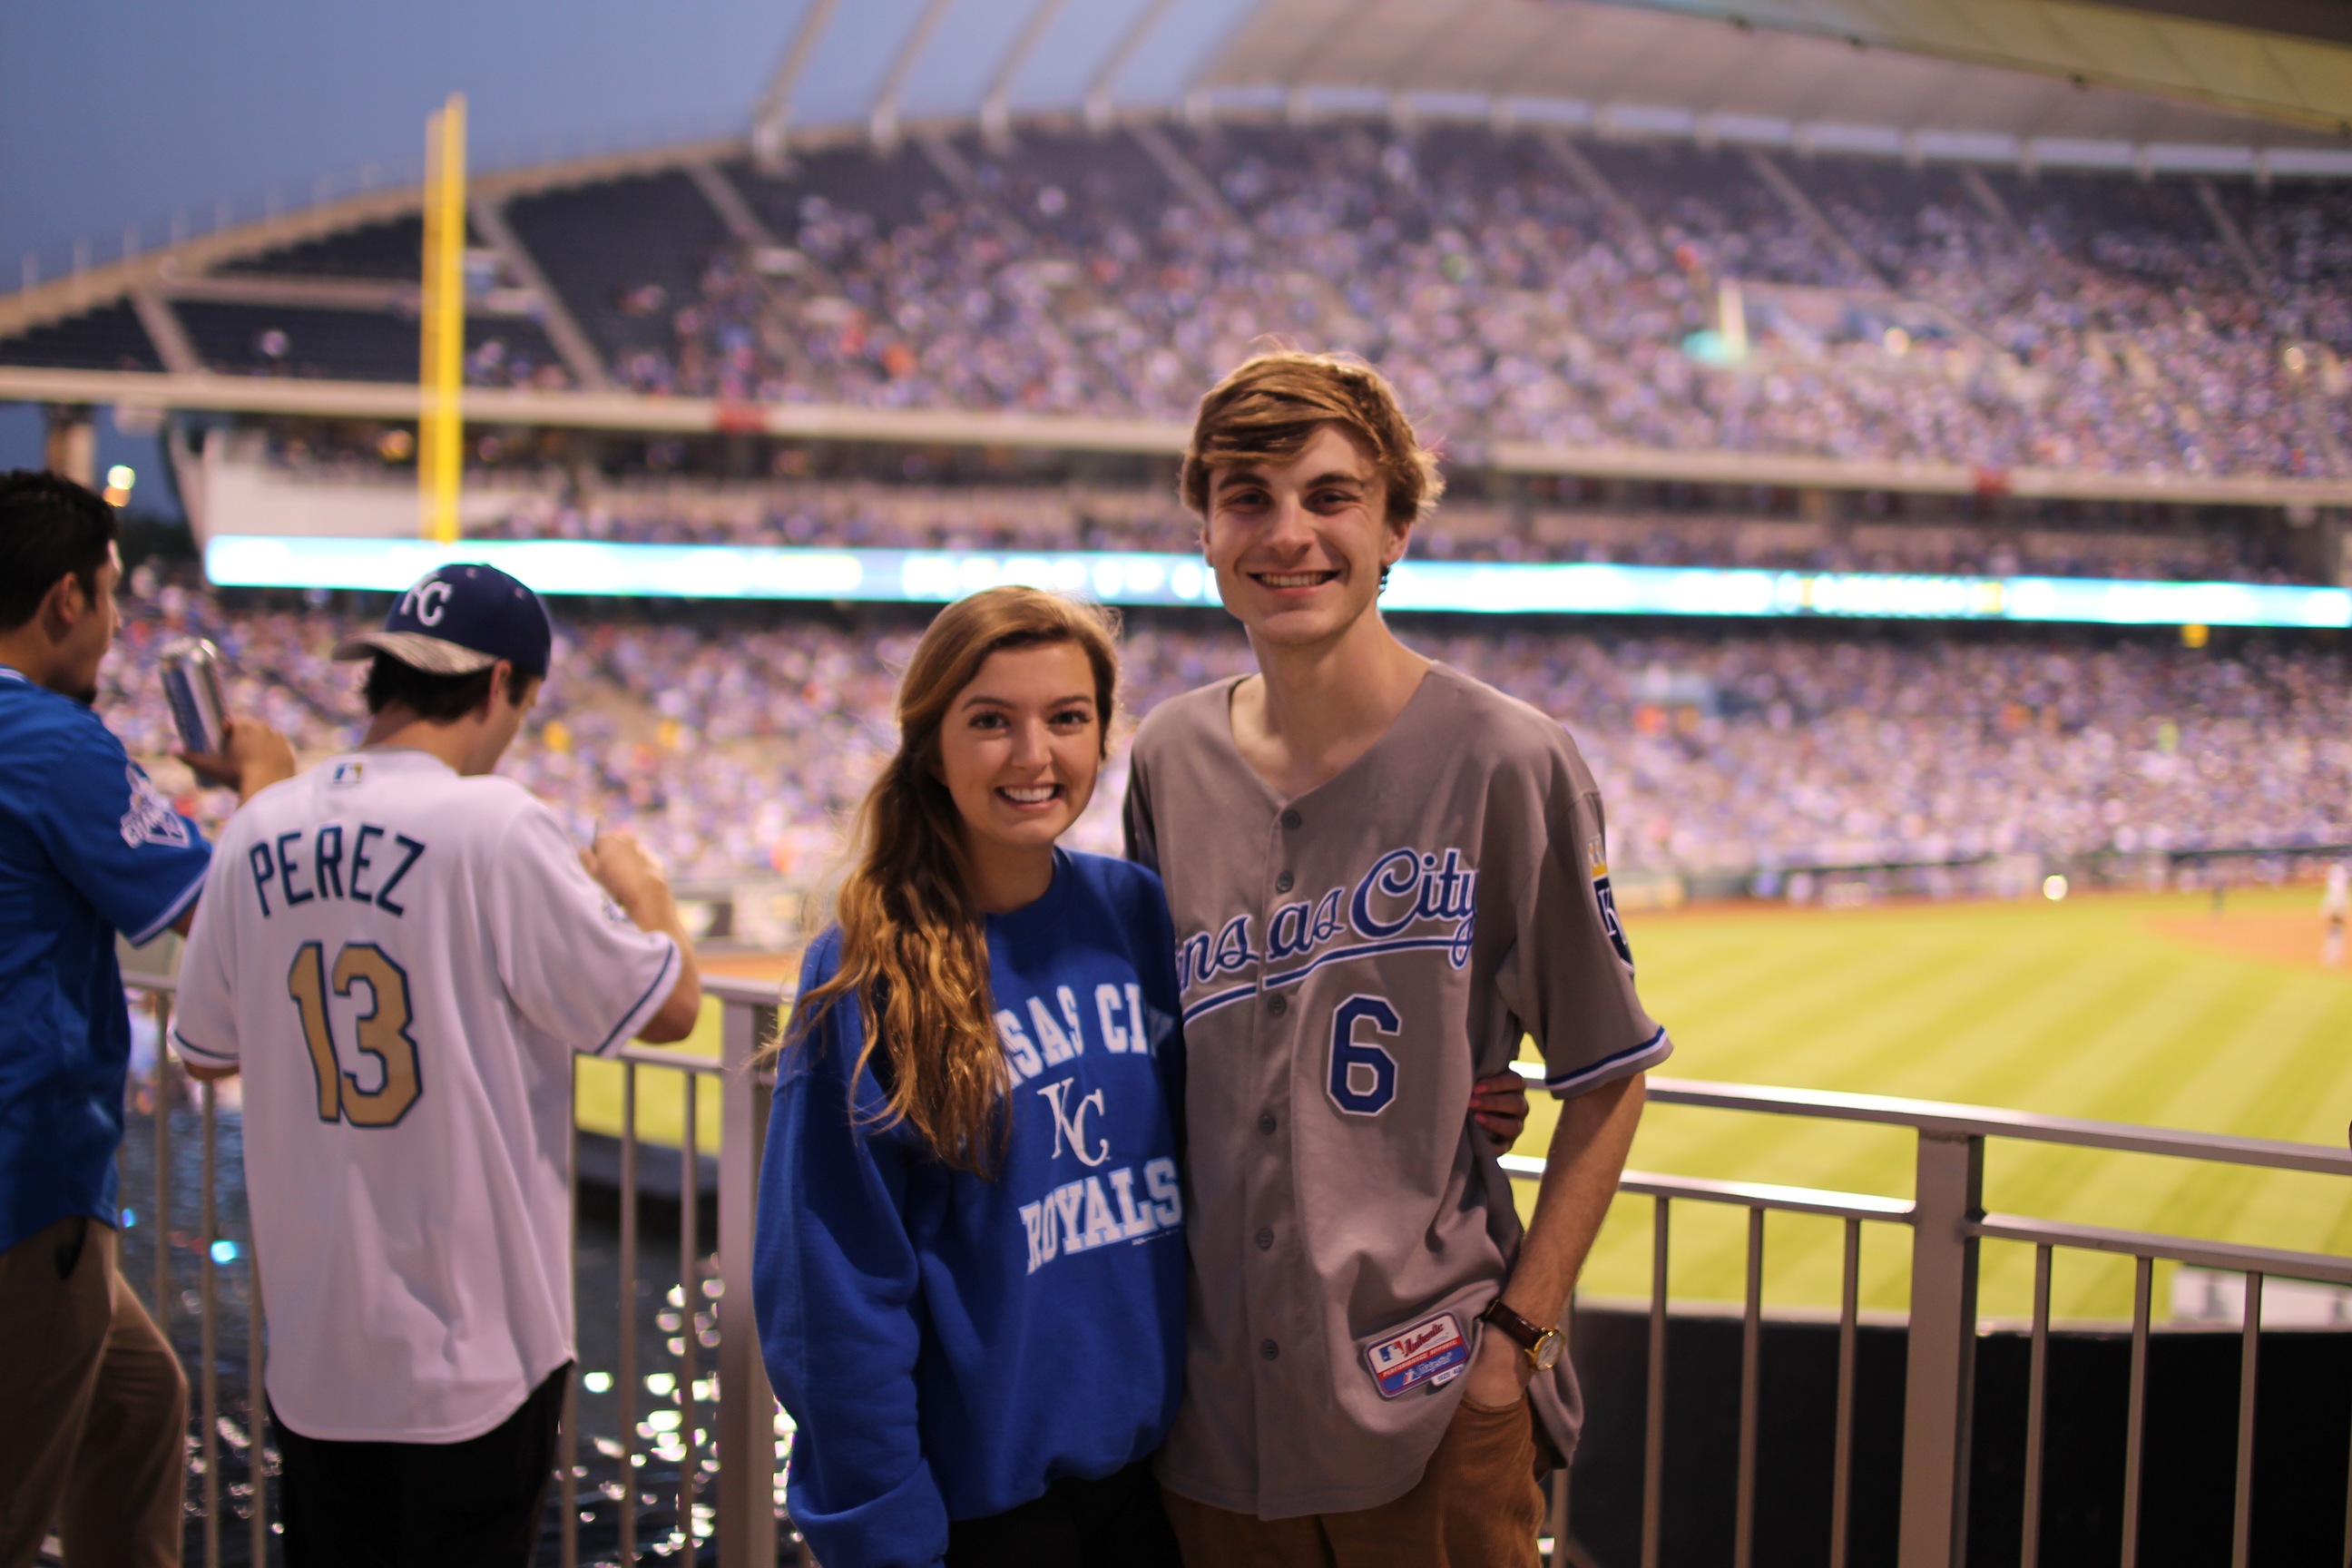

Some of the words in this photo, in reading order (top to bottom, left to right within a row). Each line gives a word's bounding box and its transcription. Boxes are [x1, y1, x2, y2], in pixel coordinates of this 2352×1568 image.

[249, 822, 426, 918] PEREZ
[1348, 847, 1479, 970] City
[287, 939, 423, 1130] 13
[995, 985, 1084, 1089] SAS
[1327, 993, 1402, 1117] 6
[1036, 1077, 1109, 1167] KC
[1018, 1156, 1182, 1276] ROYALS
